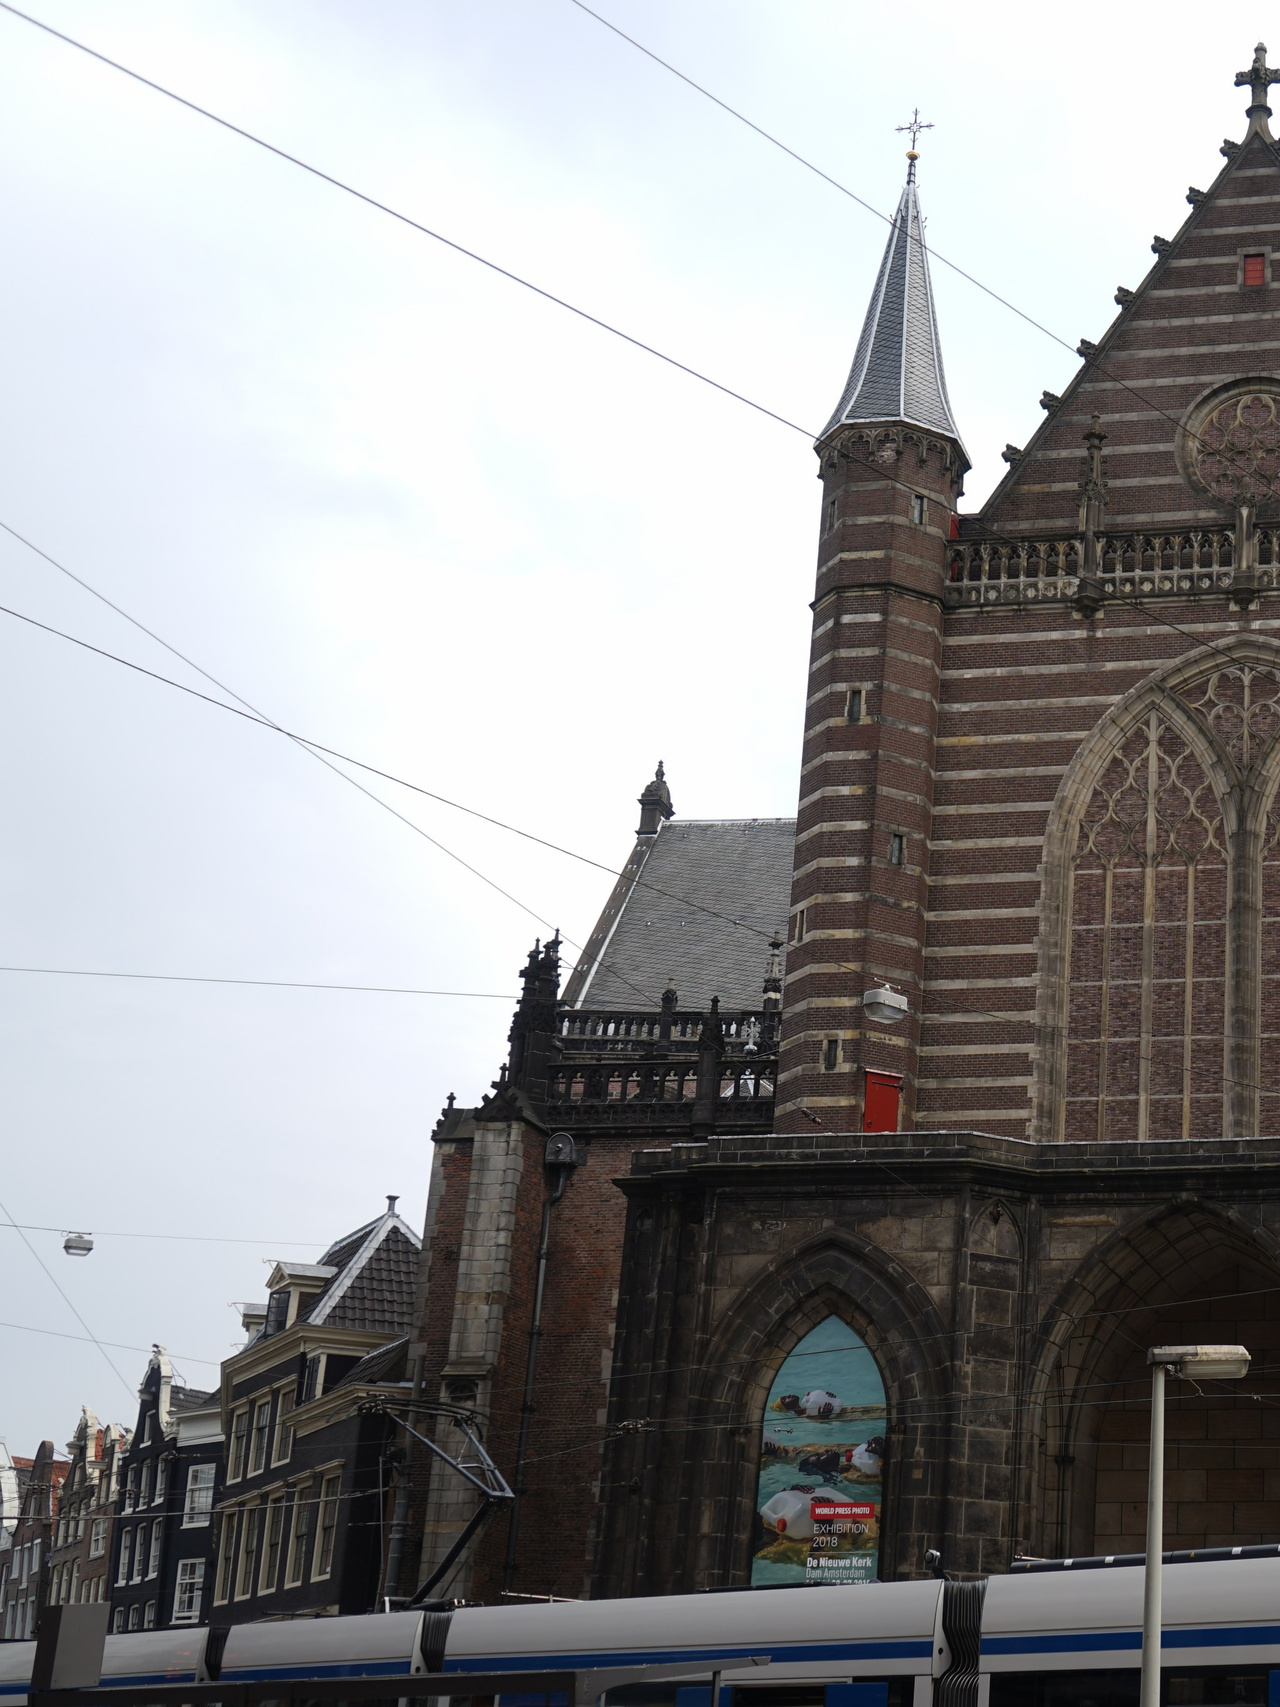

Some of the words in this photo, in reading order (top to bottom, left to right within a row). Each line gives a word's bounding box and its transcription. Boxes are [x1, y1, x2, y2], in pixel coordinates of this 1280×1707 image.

[815, 1507, 835, 1515] WORLD
[835, 1507, 852, 1515] PRESS
[852, 1507, 870, 1515] PHOTO
[813, 1523, 869, 1534] EXHIBITION
[812, 1536, 838, 1548] 2018
[806, 1557, 818, 1568] De
[819, 1557, 851, 1567] Nieuwe
[852, 1556, 872, 1567] Kerk
[806, 1568, 822, 1578] Dam
[823, 1568, 865, 1578] Amsterdam
